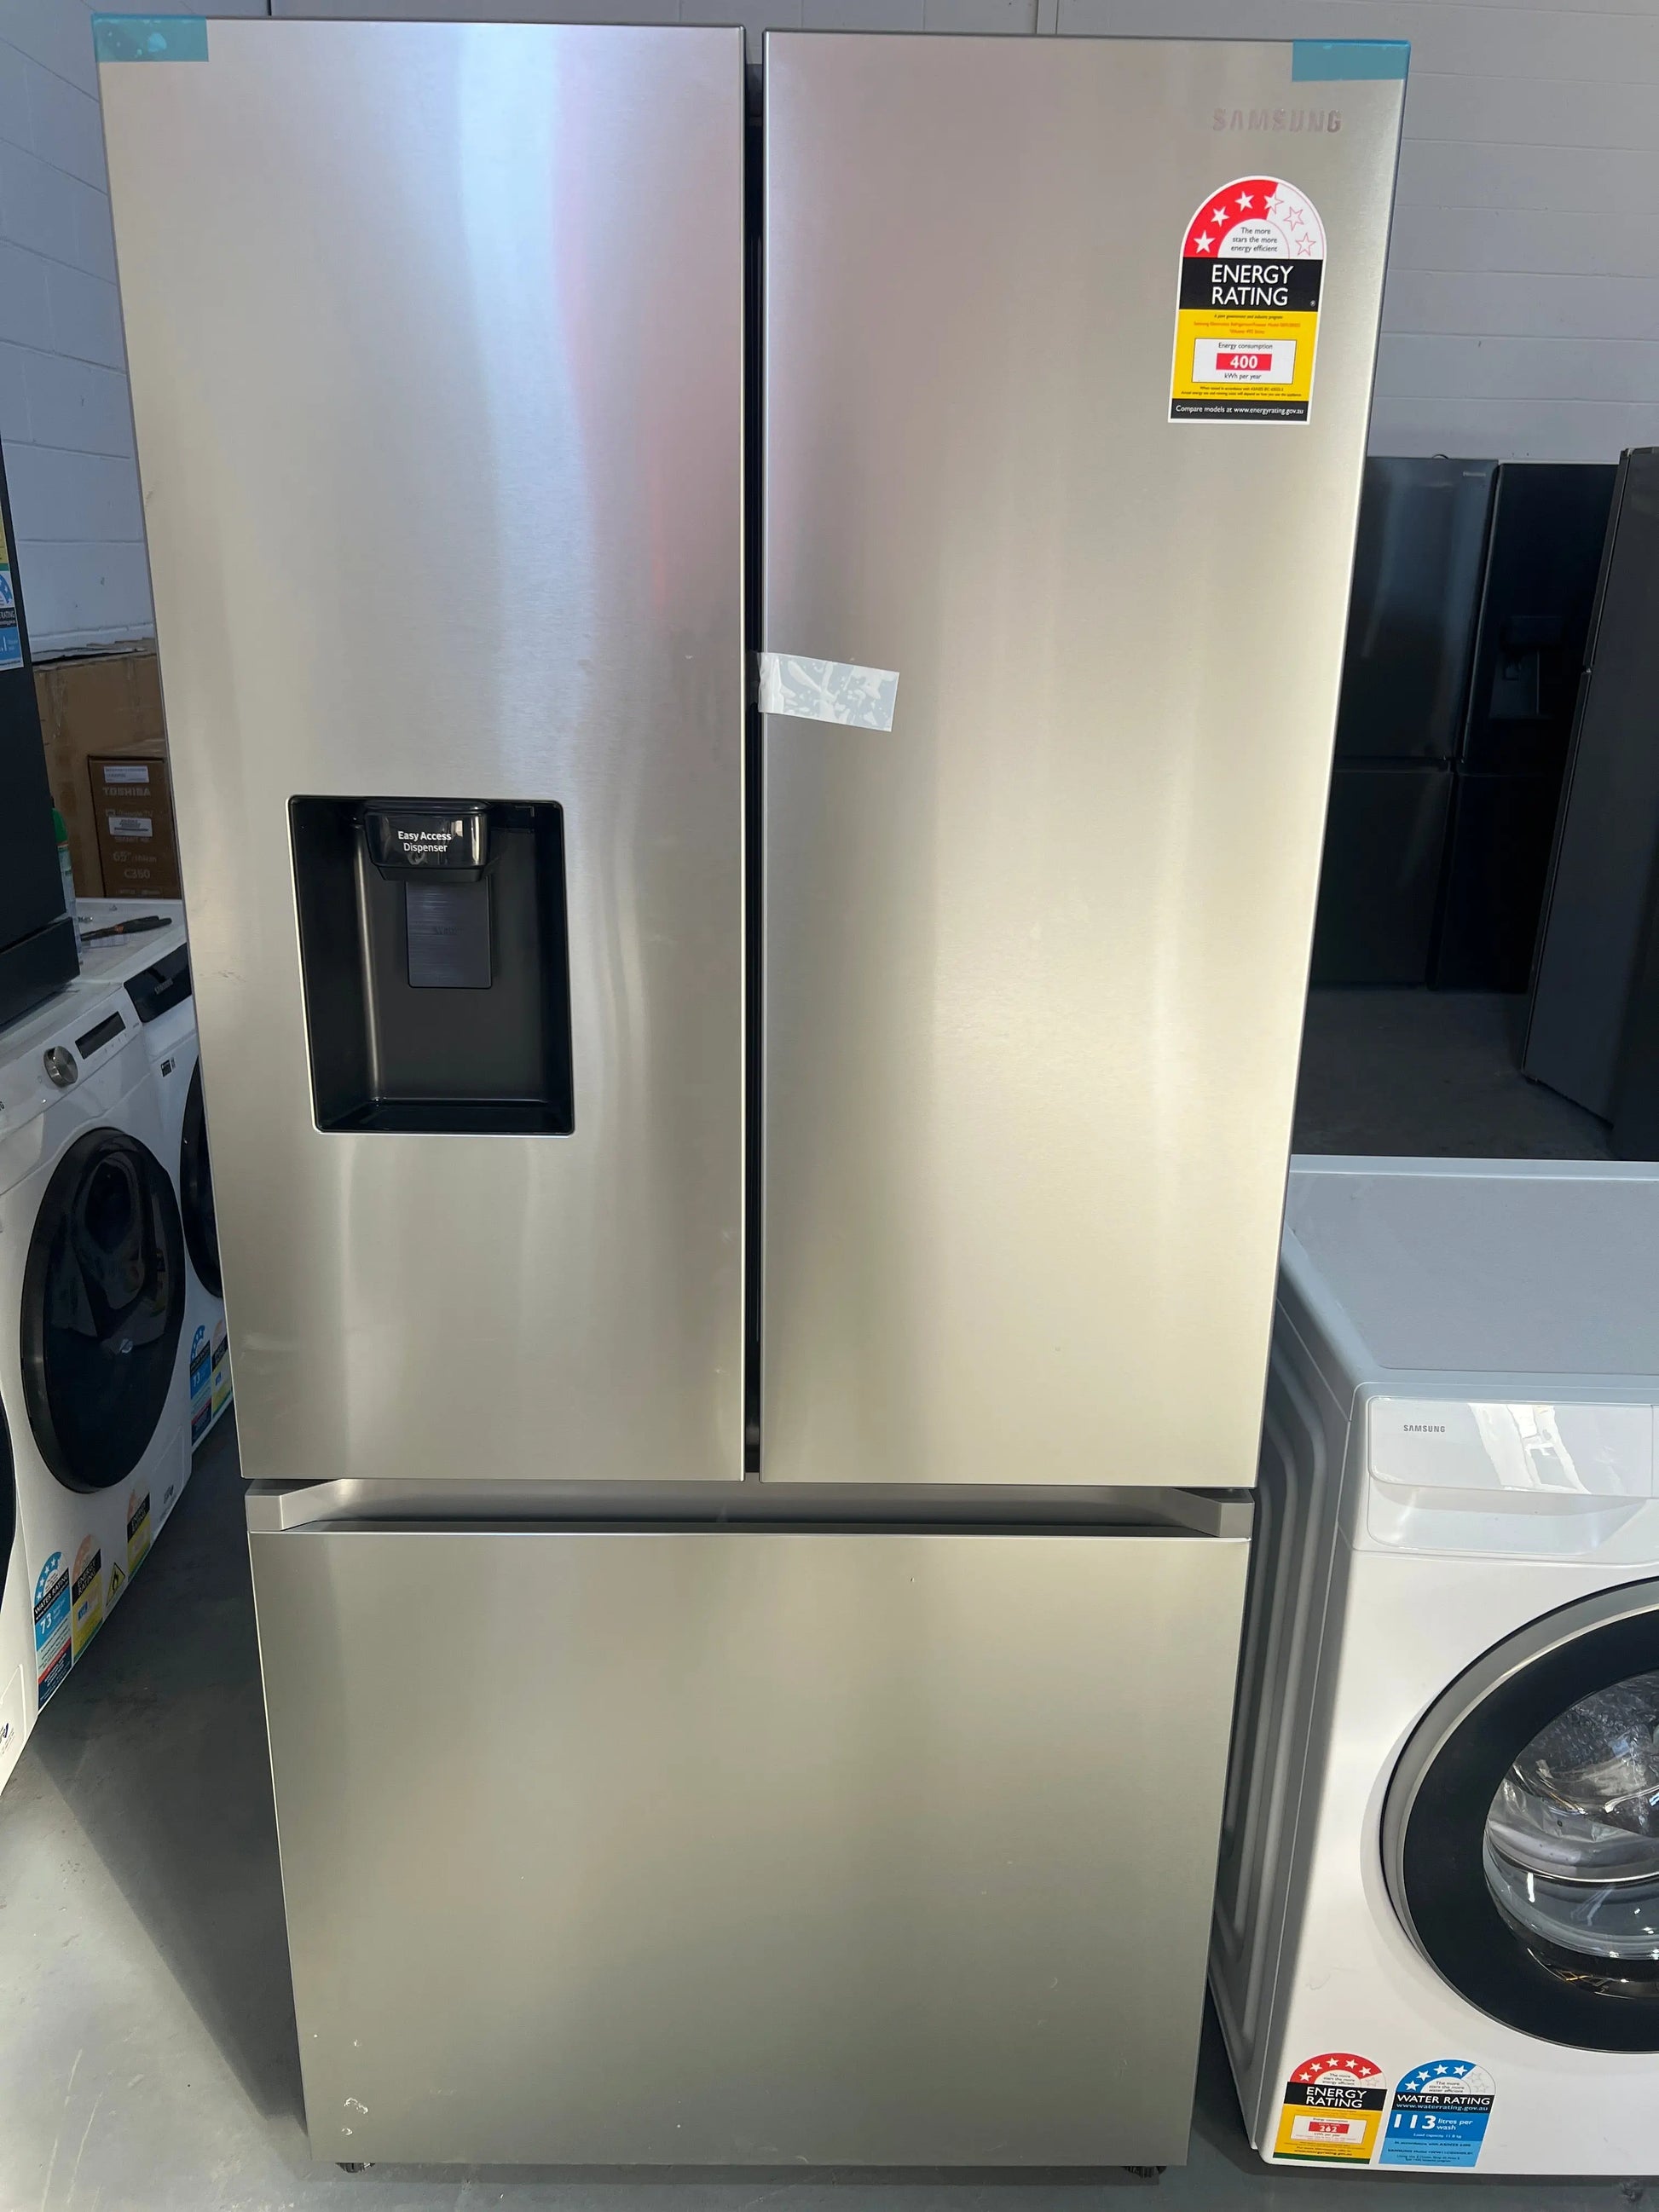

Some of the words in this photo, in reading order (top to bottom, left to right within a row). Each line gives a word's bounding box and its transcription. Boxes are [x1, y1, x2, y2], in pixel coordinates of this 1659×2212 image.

[1213, 107, 1342, 133] SAMSUNG
[1211, 264, 1294, 285] ENERGY
[1211, 286, 1289, 307] RATING
[1230, 355, 1258, 369] 400
[1176, 405, 1203, 413] Compare
[1204, 405, 1225, 413] models
[1233, 407, 1304, 416] www.energyrating.gov.au
[102, 786, 151, 796] TOSHIBA
[397, 831, 419, 842] Easy
[420, 831, 452, 841] Access
[403, 842, 448, 853] Dispenser
[1403, 1424, 1446, 1433] SAMSUNG
[34, 1592, 52, 1614] WATER
[40, 1613, 52, 1635] 73
[1306, 2087, 1368, 2099] ENERGY
[1305, 2096, 1363, 2109] RATING
[1396, 2094, 1440, 2104] WATER
[1443, 2096, 1490, 2105] RATING
[1396, 2103, 1488, 2111] www.waterrating.gov.au
[1393, 2113, 1436, 2129] 113
